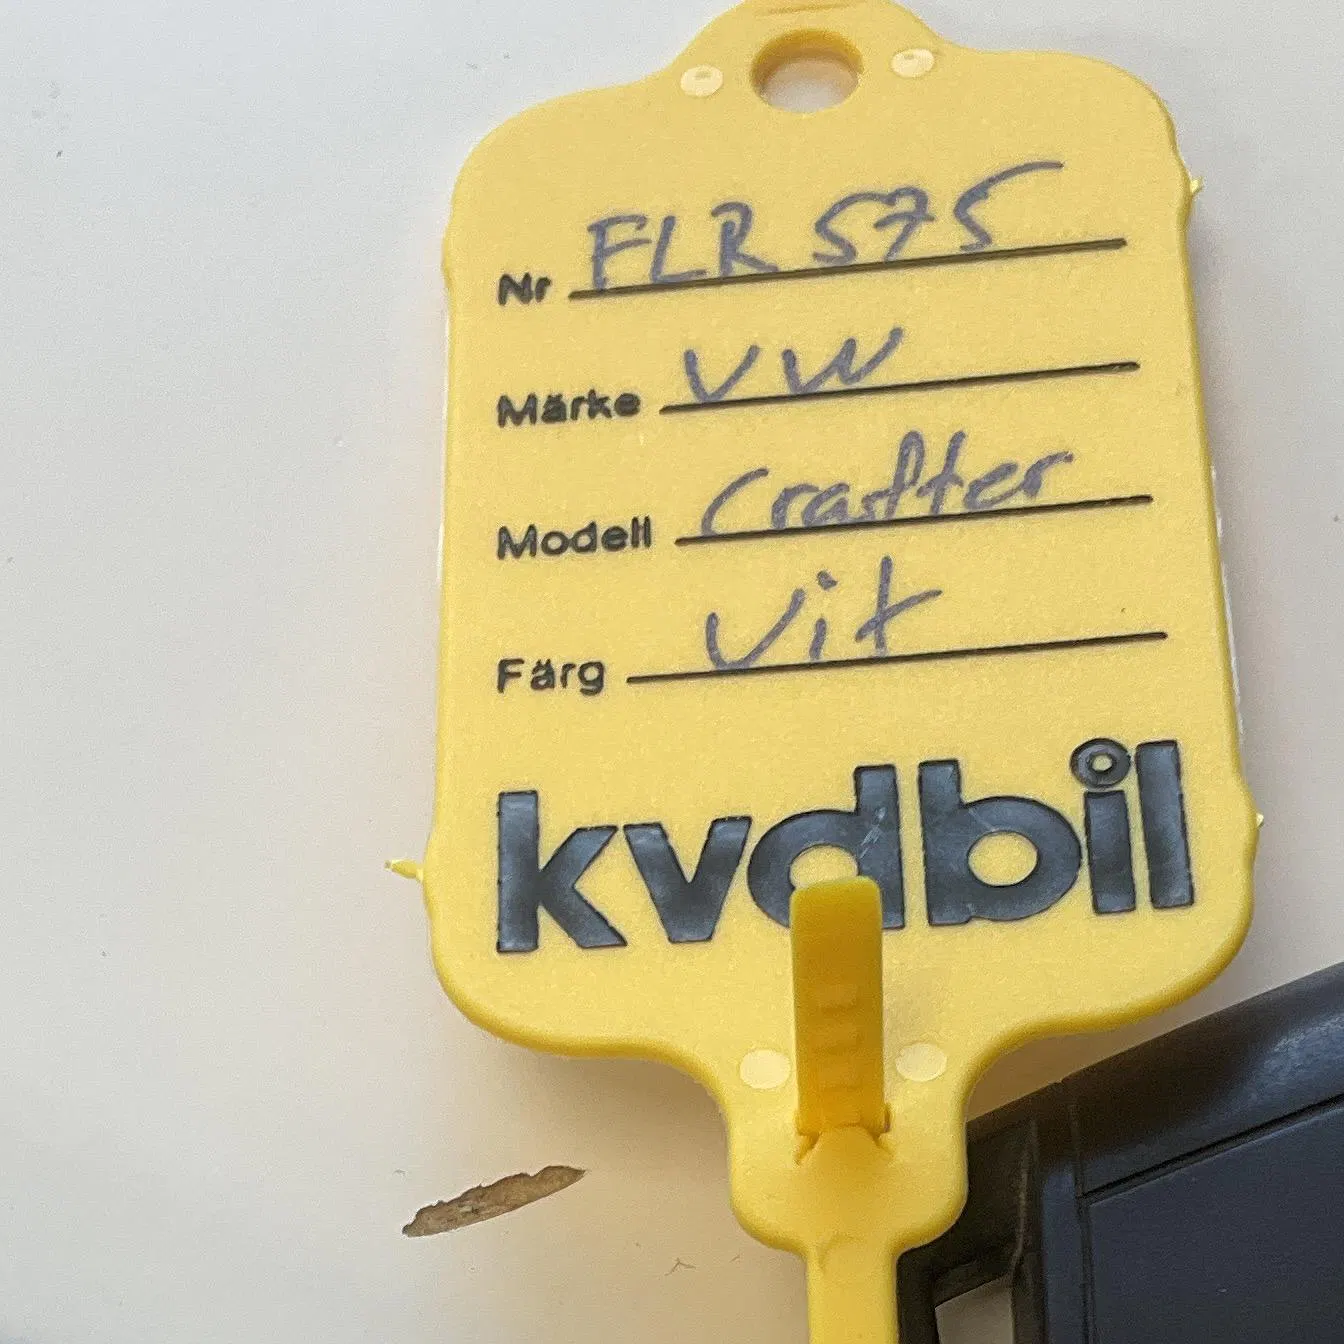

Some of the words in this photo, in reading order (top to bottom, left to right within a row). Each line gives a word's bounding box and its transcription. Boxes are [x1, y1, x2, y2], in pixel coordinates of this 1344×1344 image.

[586, 201, 778, 293] FLR
[812, 160, 1065, 266] 575
[496, 272, 551, 308] Nr
[496, 391, 643, 427] Märke
[496, 514, 654, 561] Modell
[496, 655, 607, 697] Färg
[495, 737, 1196, 955] kvdbil
